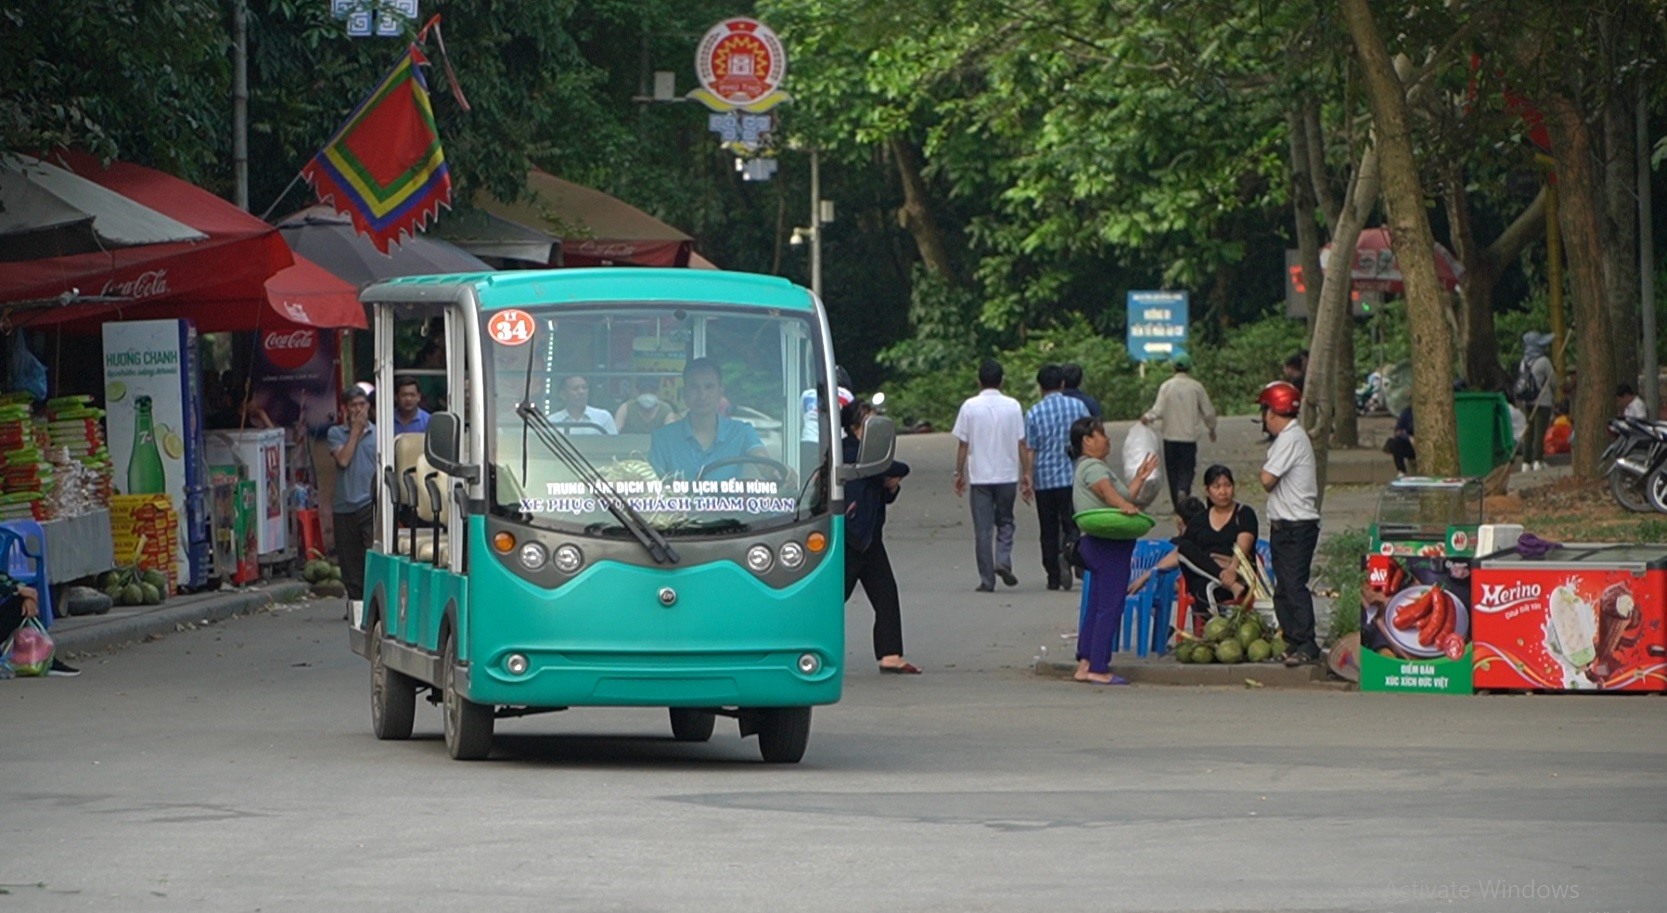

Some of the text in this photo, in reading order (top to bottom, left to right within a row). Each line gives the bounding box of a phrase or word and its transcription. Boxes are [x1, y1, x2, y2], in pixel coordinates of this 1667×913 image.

[497, 320, 528, 340] 34
[143, 350, 178, 365] CHANH
[546, 482, 585, 495] TRUNG
[519, 497, 544, 512] XE
[546, 497, 595, 515] PHỤC
[694, 496, 744, 512] THAM
[747, 497, 795, 514] QUAN
[1481, 580, 1541, 604] Merino
